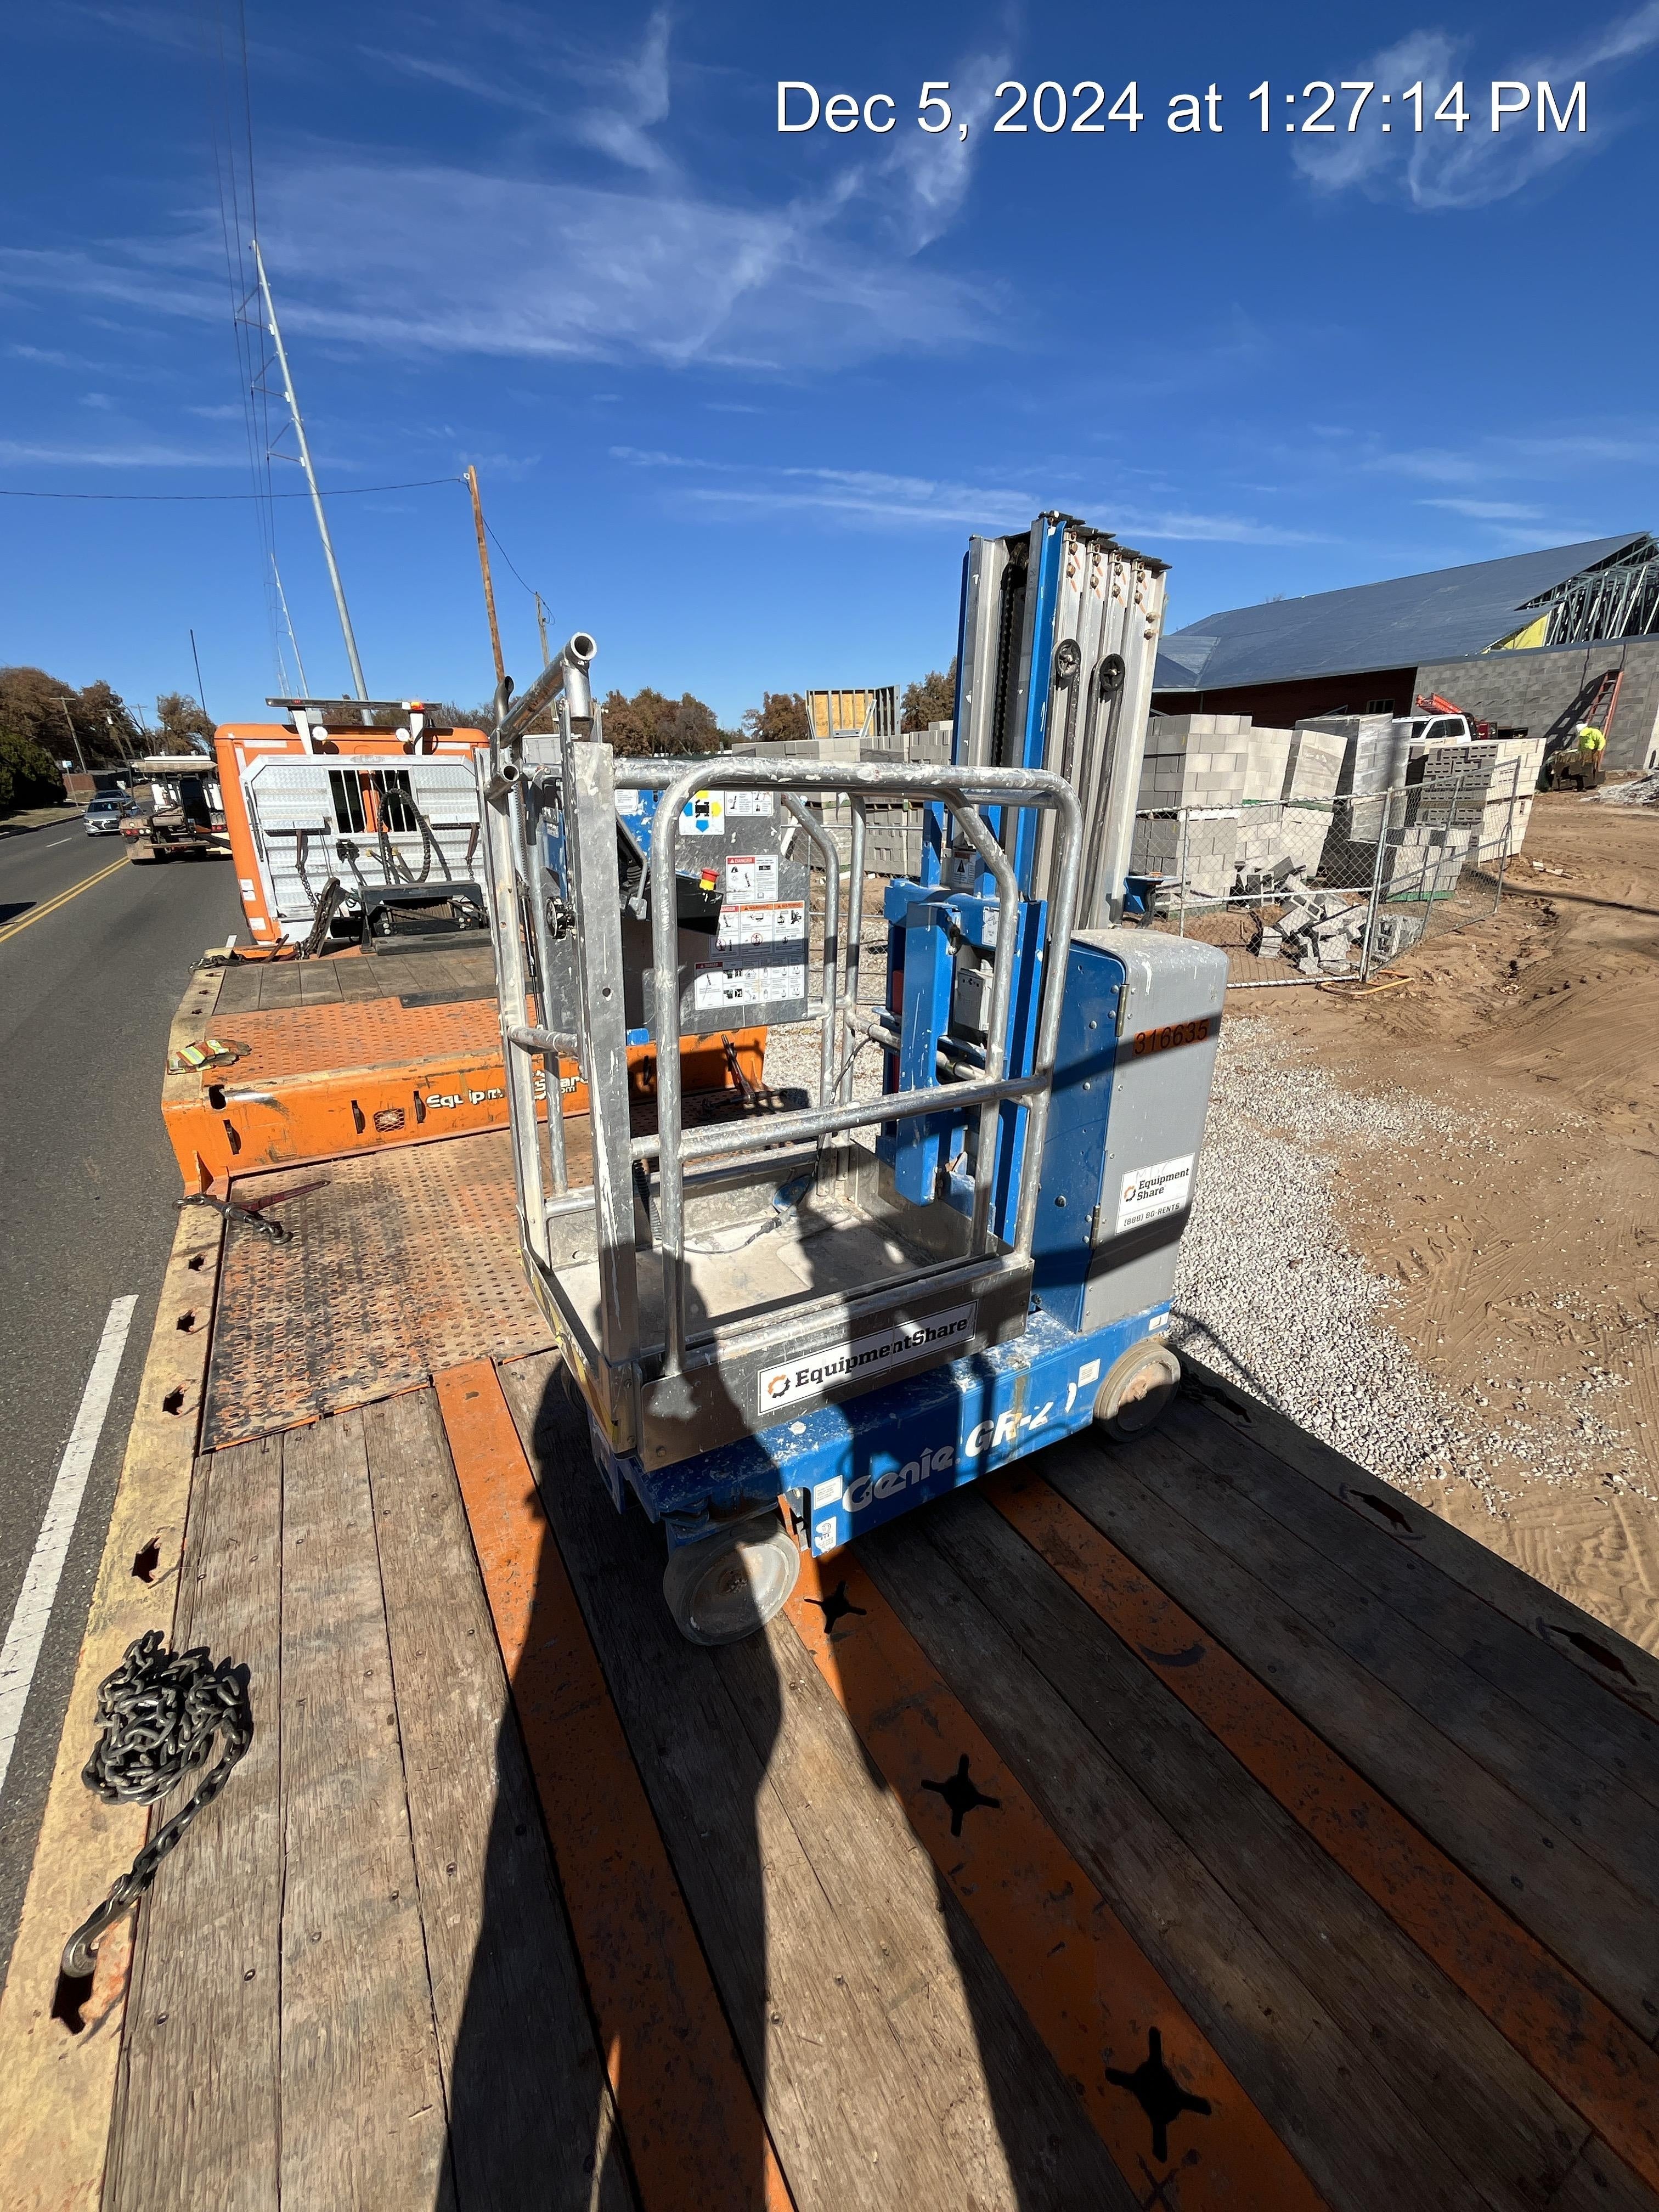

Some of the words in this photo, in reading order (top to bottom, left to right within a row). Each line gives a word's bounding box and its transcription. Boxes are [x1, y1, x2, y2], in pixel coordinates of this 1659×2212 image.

[1134, 1018, 1209, 1054] 316635
[1137, 1186, 1165, 1201] Share
[1138, 1167, 1189, 1190] Equipment
[1124, 1213, 1144, 1227] (888)
[1146, 1203, 1180, 1219] 80-RENTS
[795, 1318, 968, 1382] EquipmentShare
[842, 1445, 955, 1513] Genie
